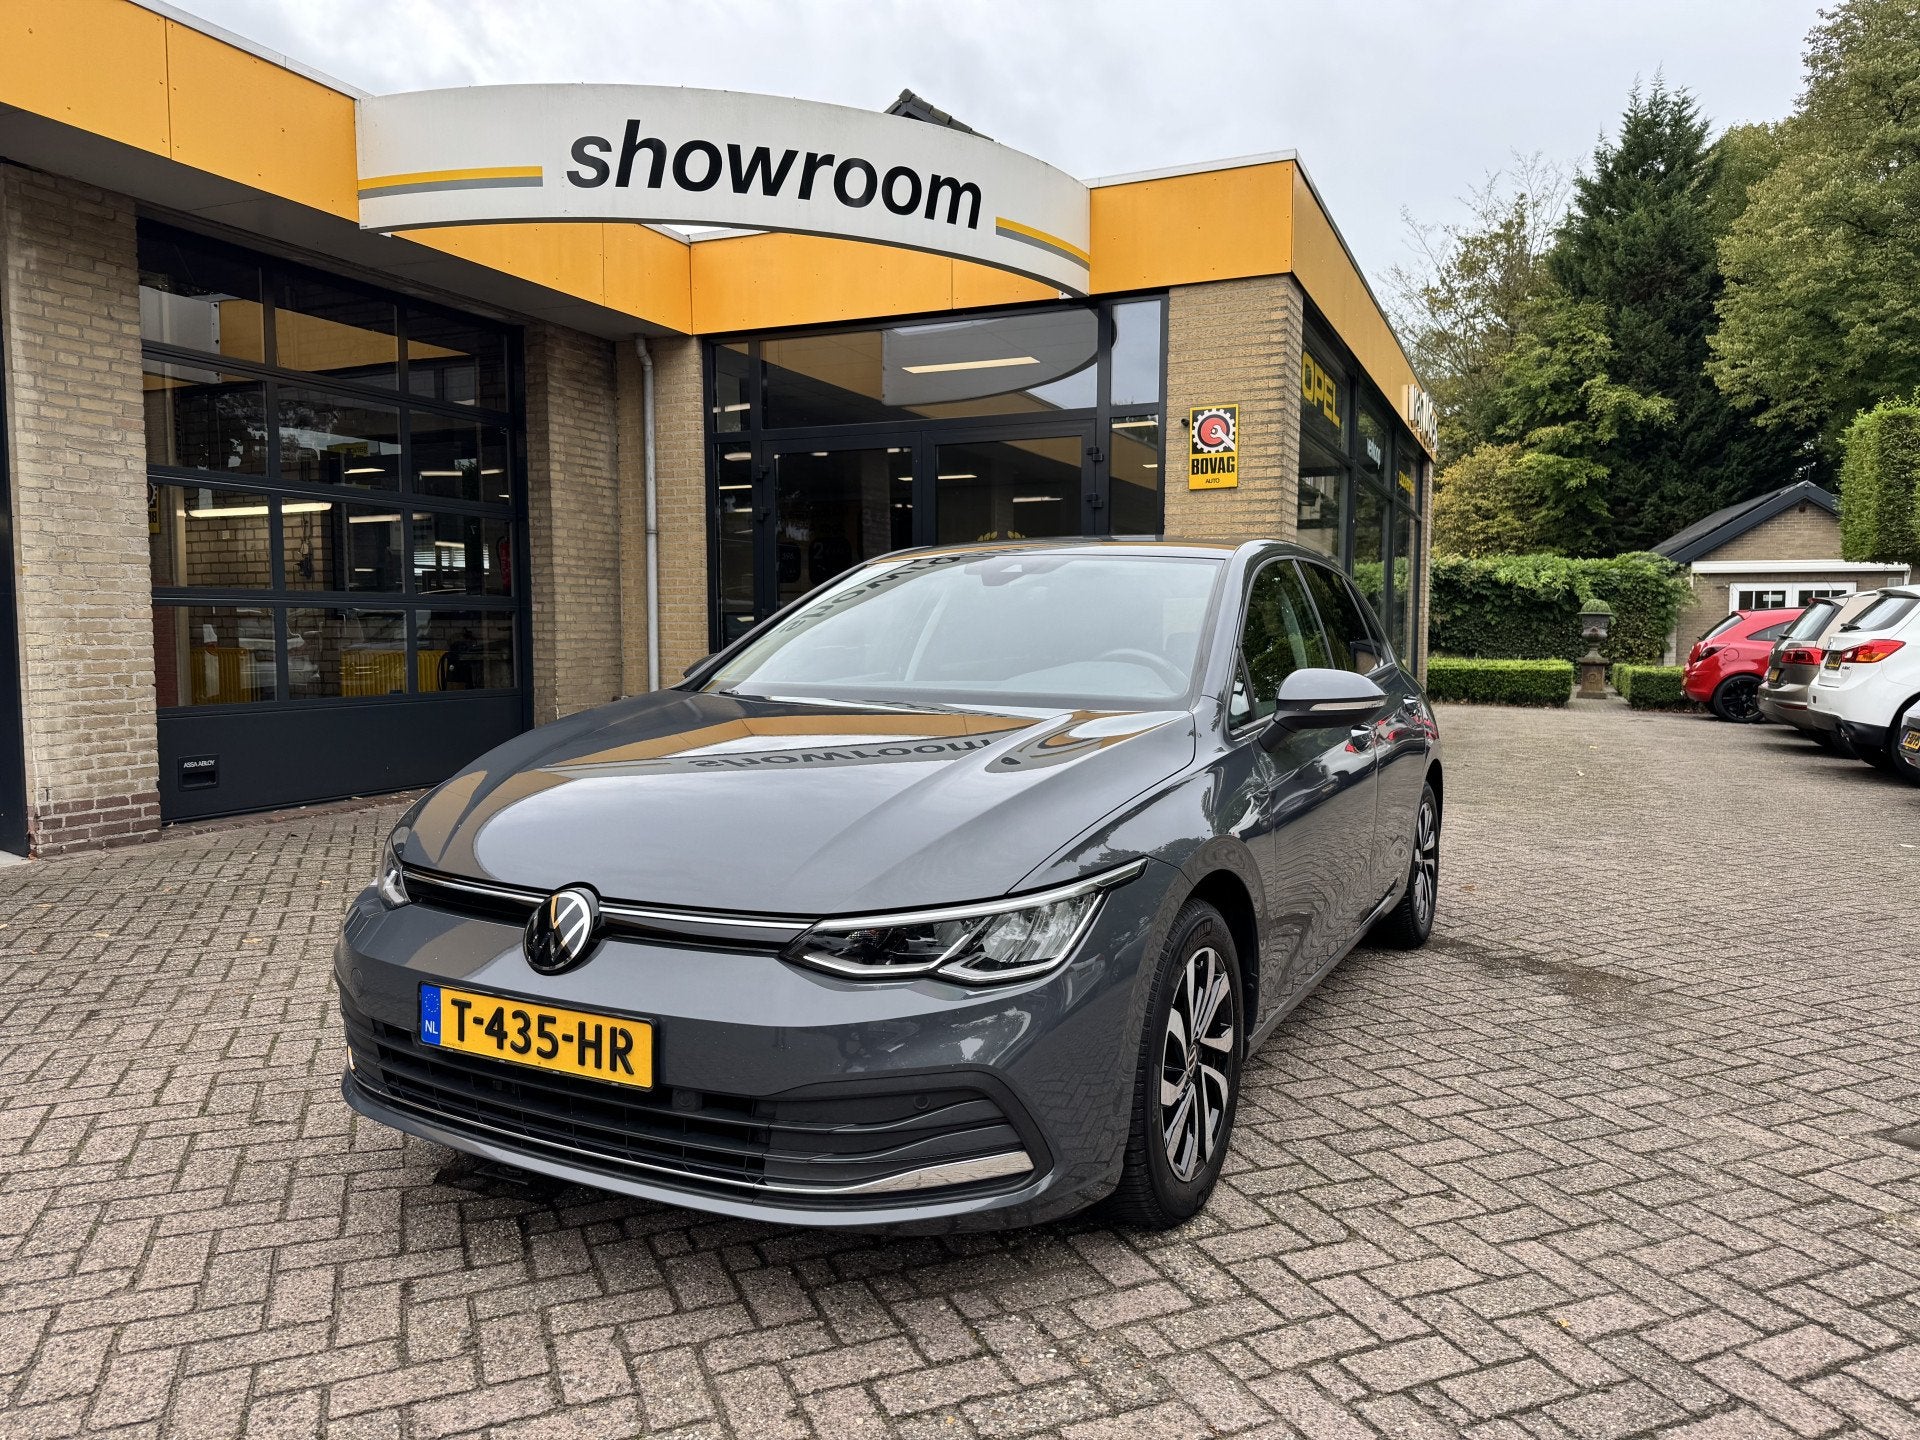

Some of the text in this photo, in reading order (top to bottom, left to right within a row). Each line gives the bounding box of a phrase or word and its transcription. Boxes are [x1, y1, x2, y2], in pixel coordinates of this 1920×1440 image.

[566, 119, 982, 230] showroom
[1301, 351, 1340, 428] OPEL
[1191, 456, 1235, 475] BOVAG
[425, 1019, 438, 1035] NL
[450, 998, 635, 1076] T-435-HR
